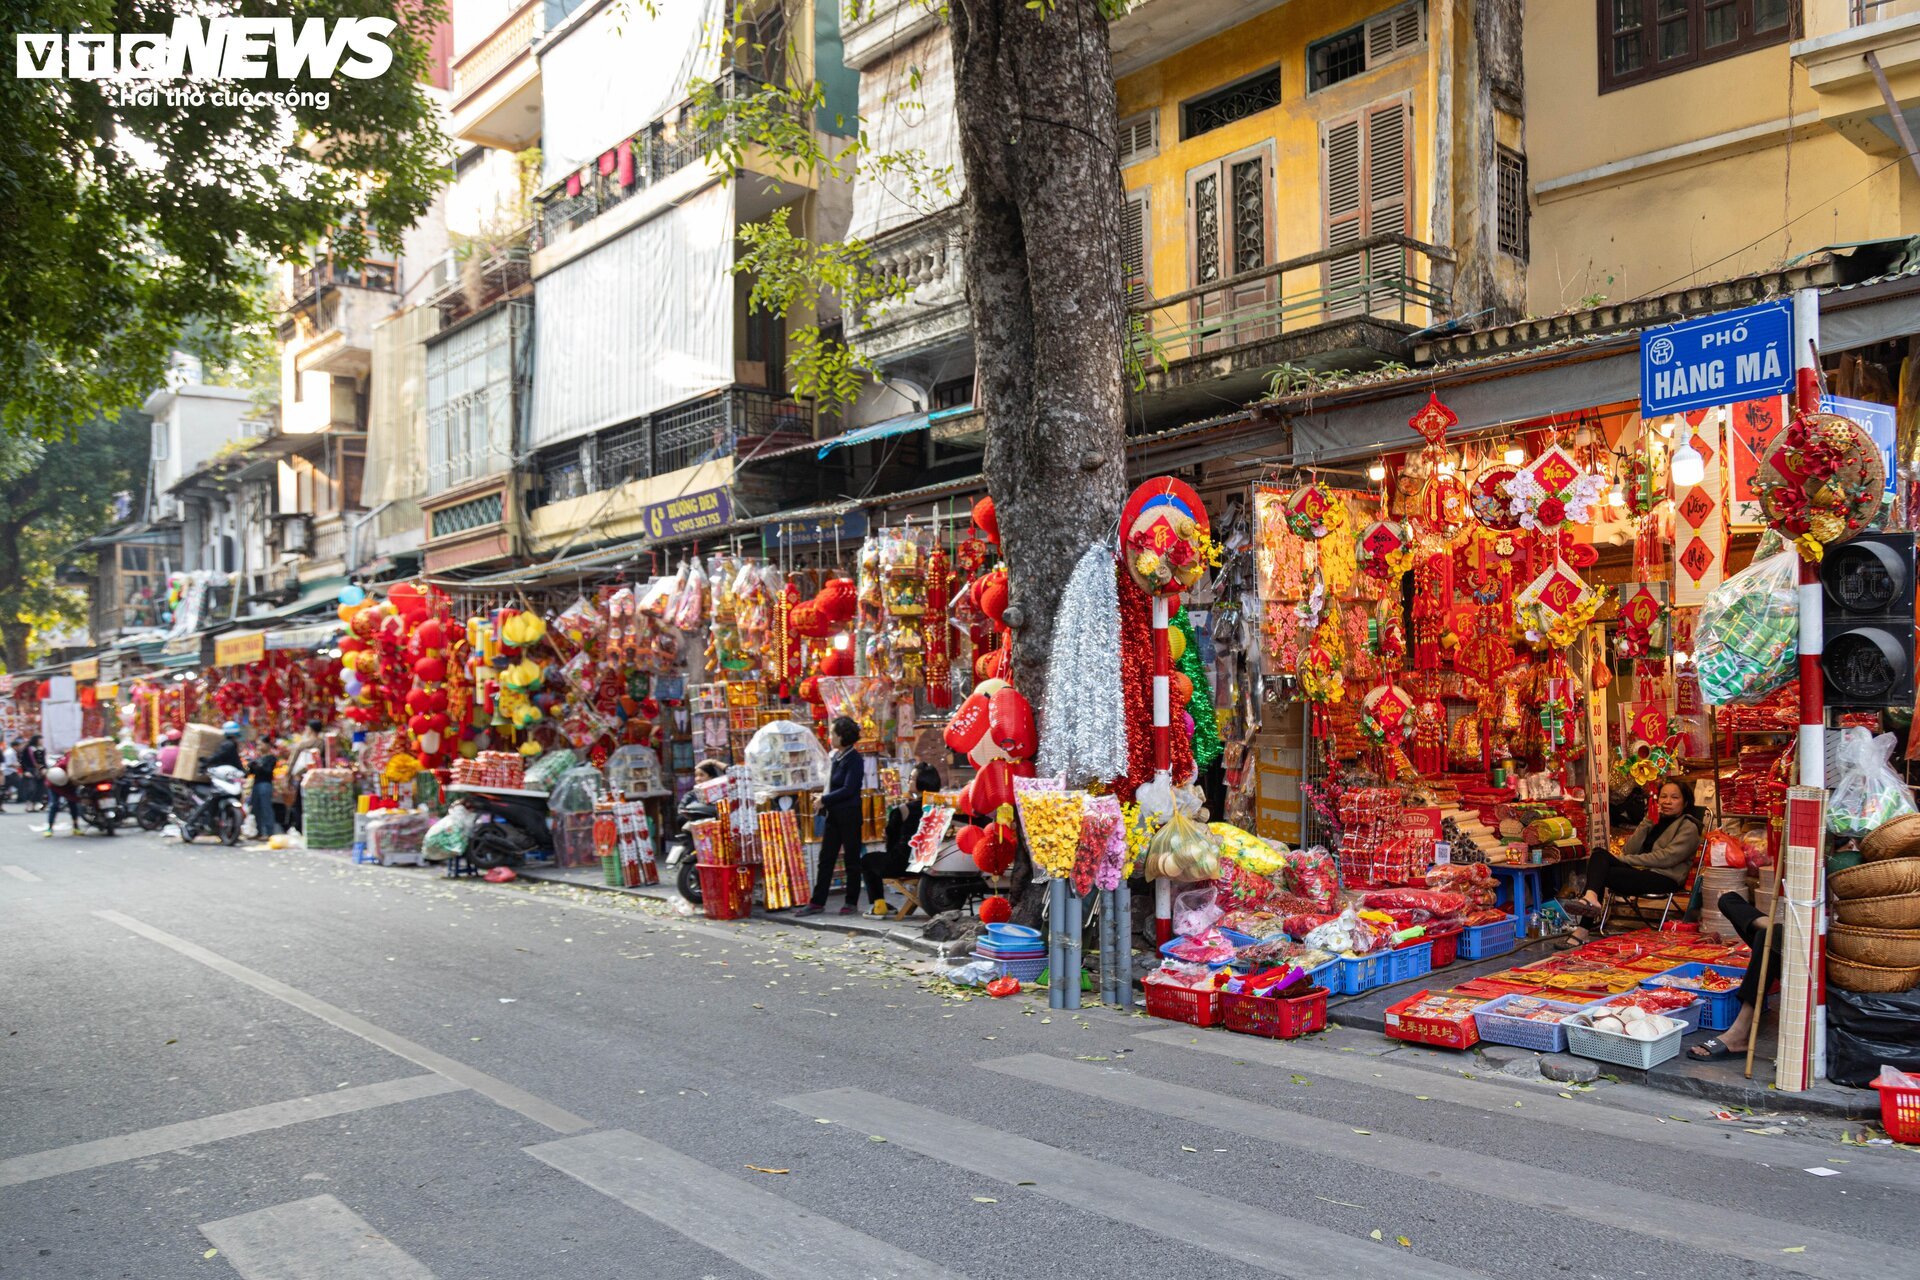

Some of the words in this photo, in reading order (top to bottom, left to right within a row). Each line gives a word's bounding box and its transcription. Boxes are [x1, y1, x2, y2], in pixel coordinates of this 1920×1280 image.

[1701, 318, 1749, 349] PHỐ
[1655, 359, 1725, 400] HÀNG
[1736, 340, 1782, 385] MÃ
